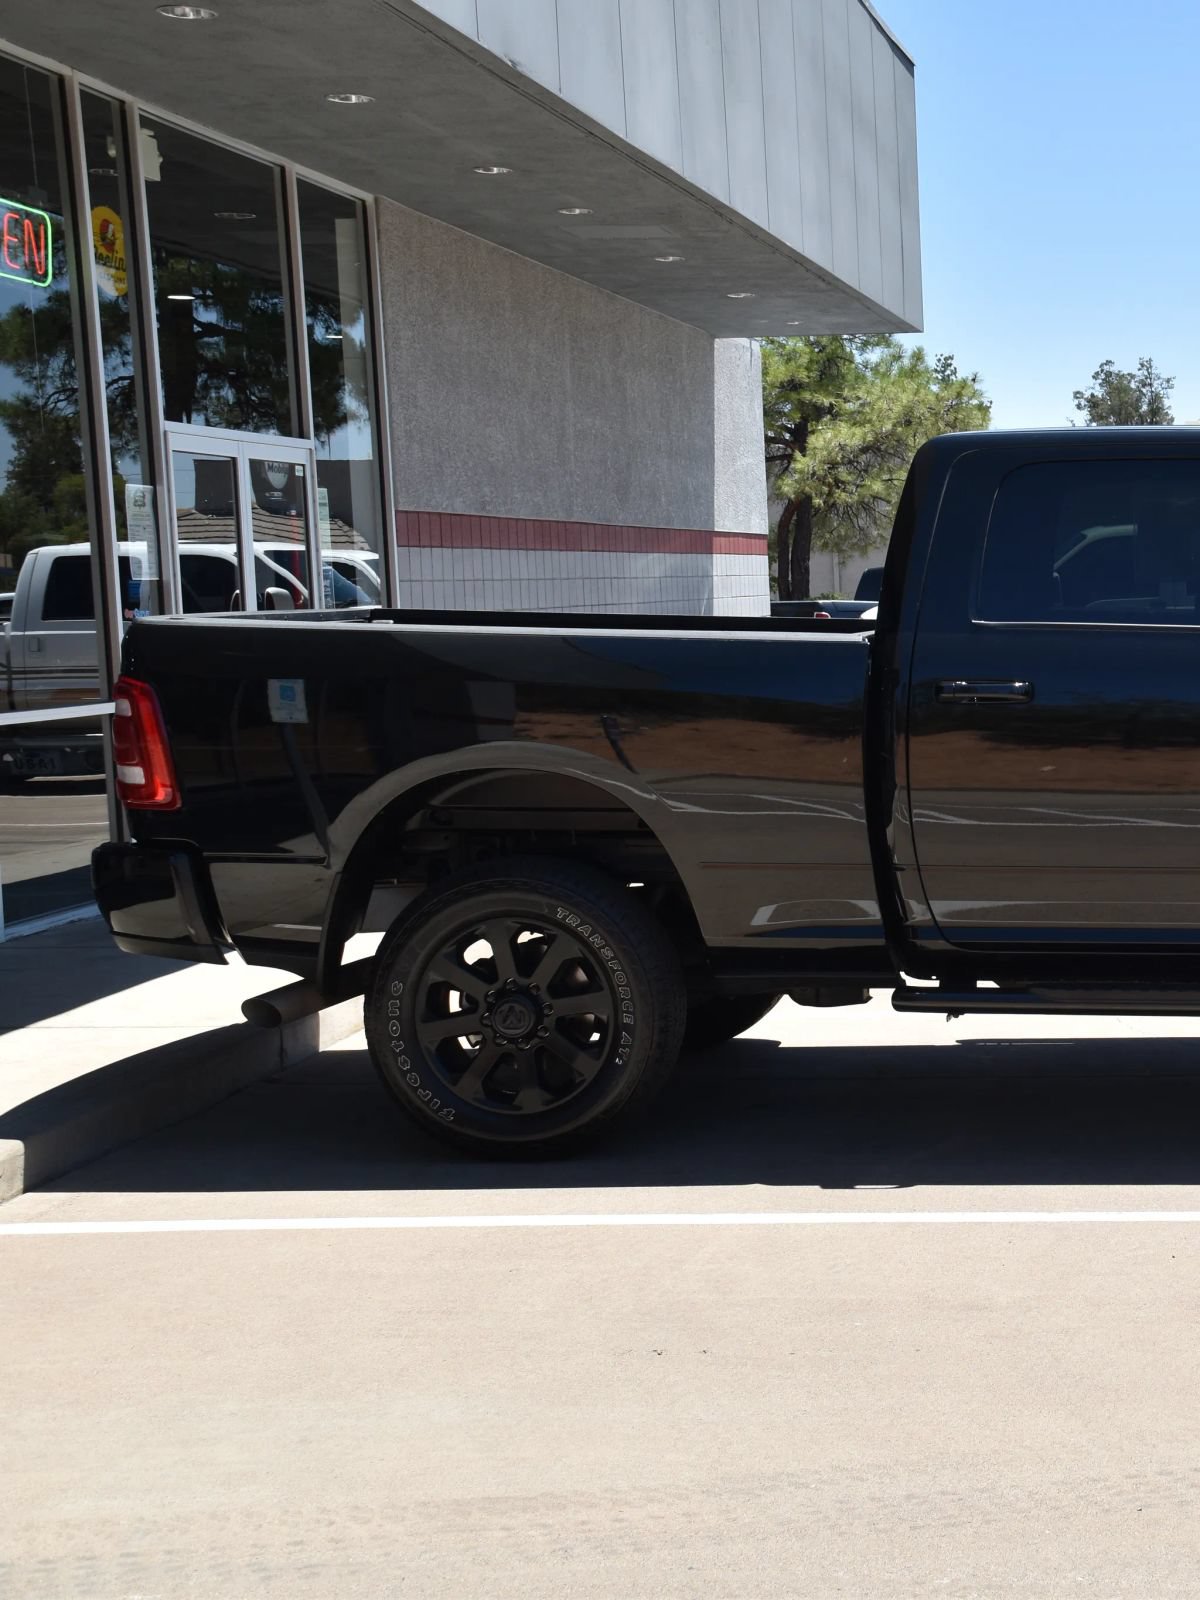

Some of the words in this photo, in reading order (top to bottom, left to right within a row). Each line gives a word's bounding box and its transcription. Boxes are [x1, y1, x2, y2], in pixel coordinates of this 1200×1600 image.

[3, 211, 46, 275] EN
[555, 906, 634, 1025] TRANSFORCE
[388, 980, 456, 1121] Firestone
